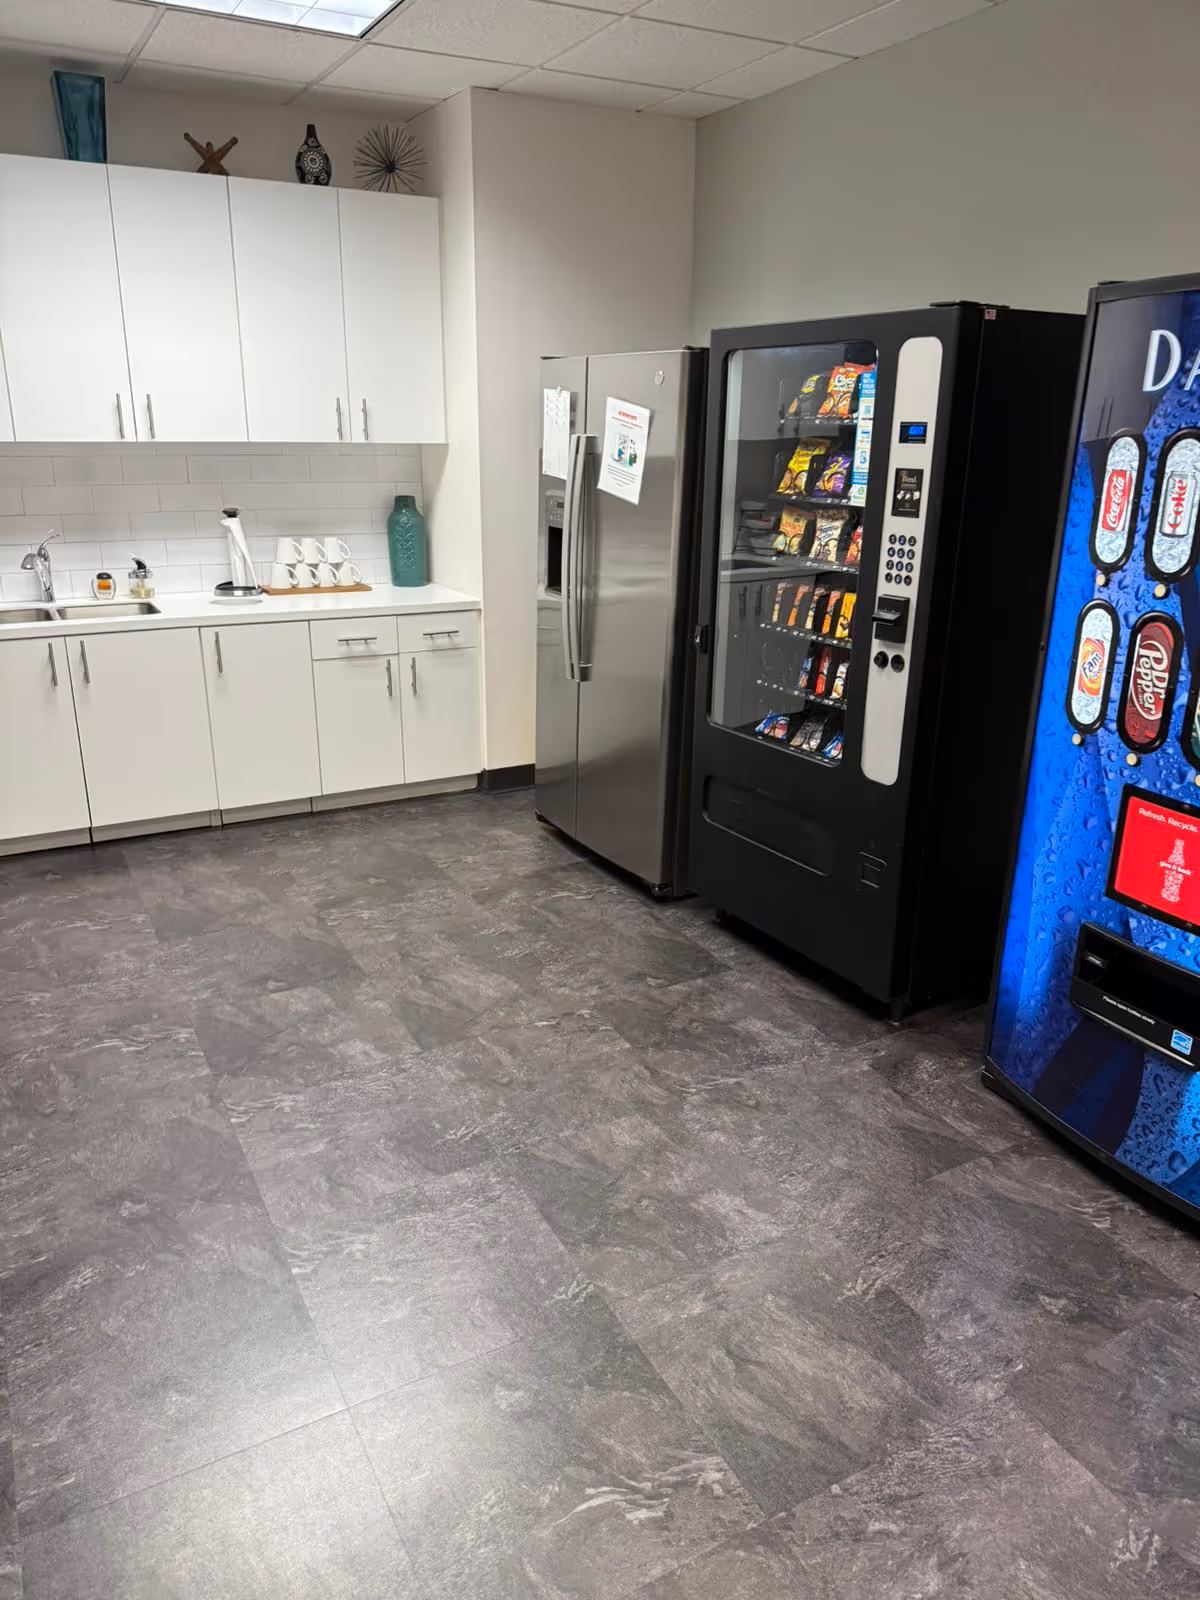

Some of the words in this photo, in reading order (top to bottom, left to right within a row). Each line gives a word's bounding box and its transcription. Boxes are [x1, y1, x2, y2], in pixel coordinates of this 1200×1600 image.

[1166, 479, 1188, 529] Coke
[1136, 641, 1168, 715] Pepper
[1151, 670, 1170, 699] Dr
[1167, 817, 1199, 833] Recycle.
